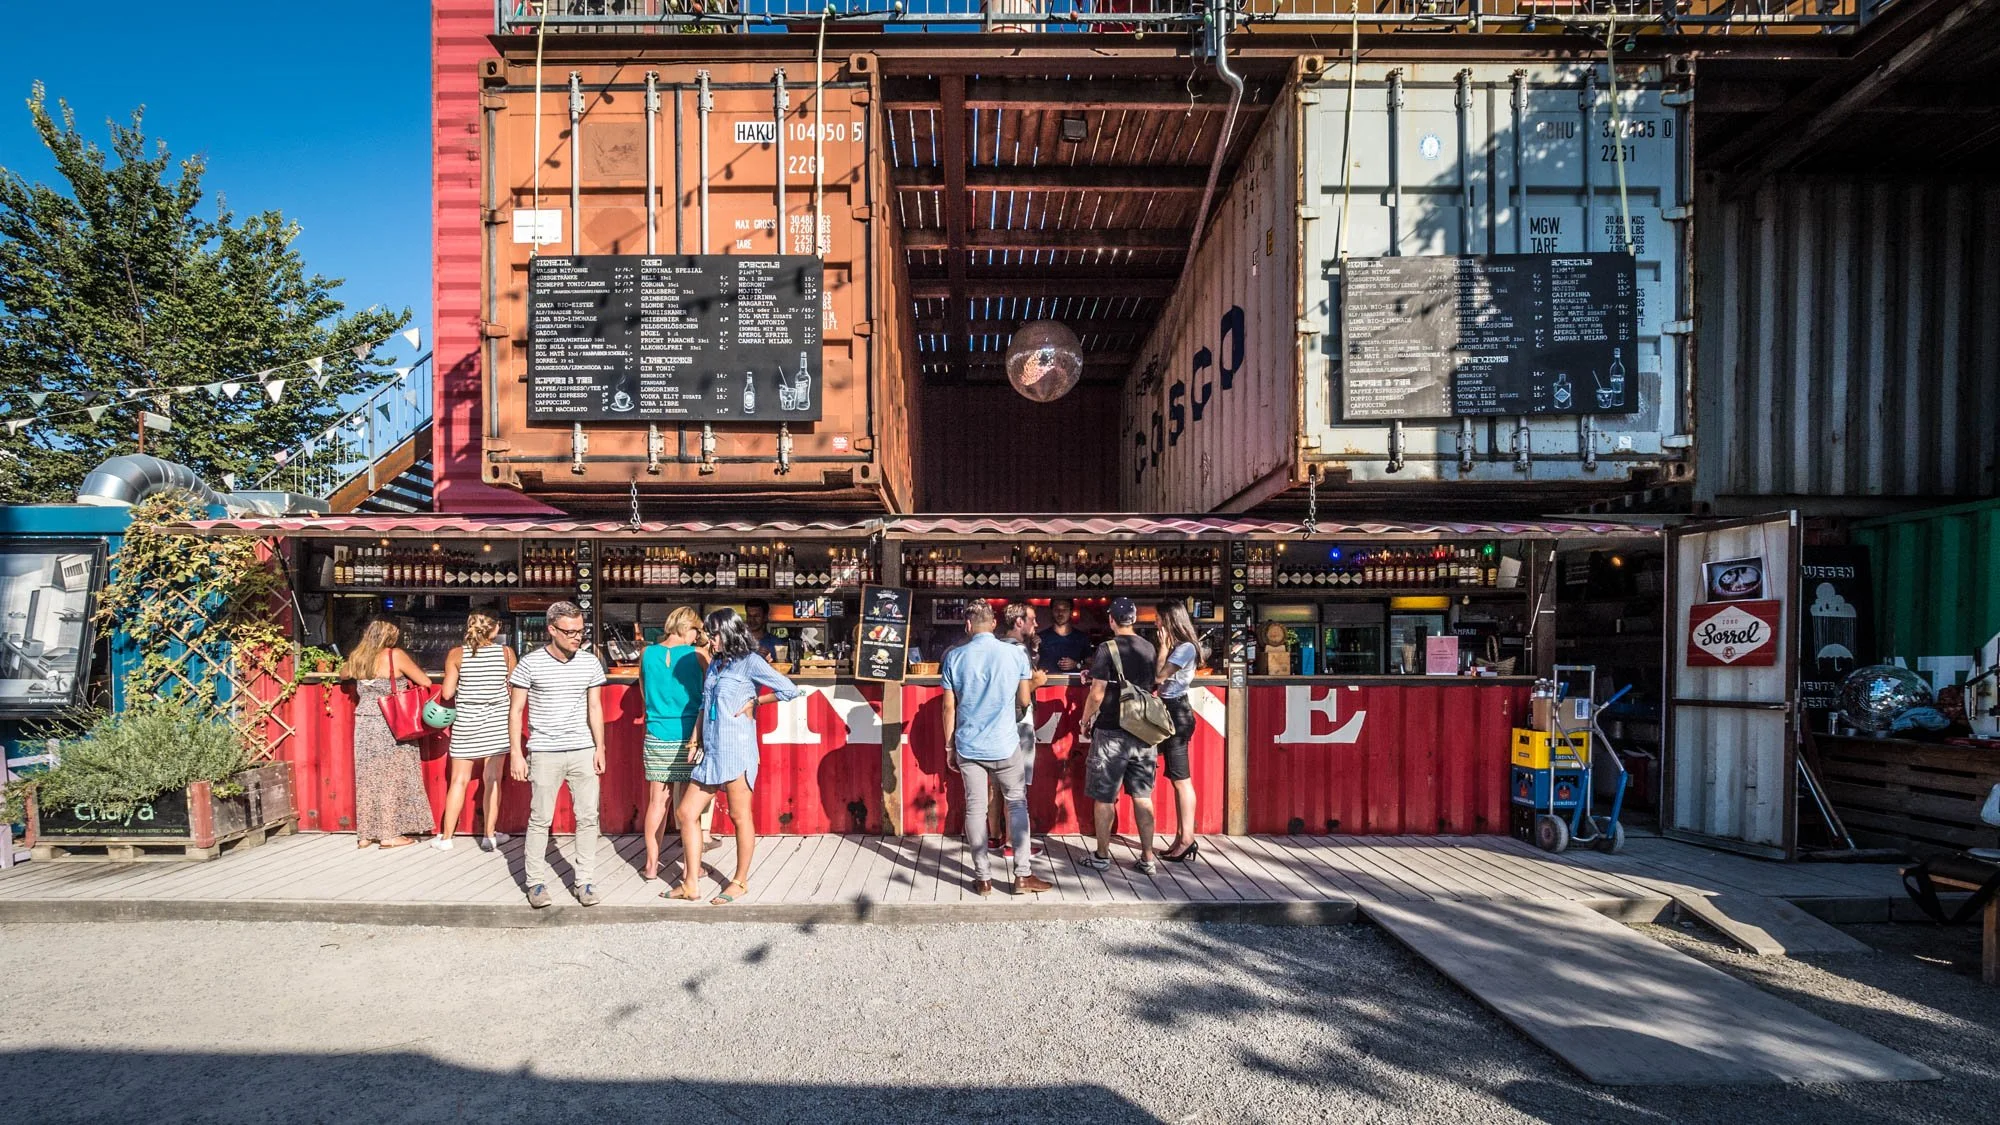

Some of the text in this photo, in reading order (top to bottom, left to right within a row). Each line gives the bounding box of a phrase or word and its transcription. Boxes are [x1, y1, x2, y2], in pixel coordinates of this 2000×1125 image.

[738, 124, 776, 140] HAKU
[736, 220, 776, 229] MAX GROSS
[1605, 216, 1645, 224] 30.48 KGS
[1530, 217, 1562, 234] MGW.
[1632, 226, 1645, 234] LBS
[736, 240, 752, 249] TARE
[1632, 236, 1645, 244] KGS
[1698, 621, 1760, 646] Sorrel
